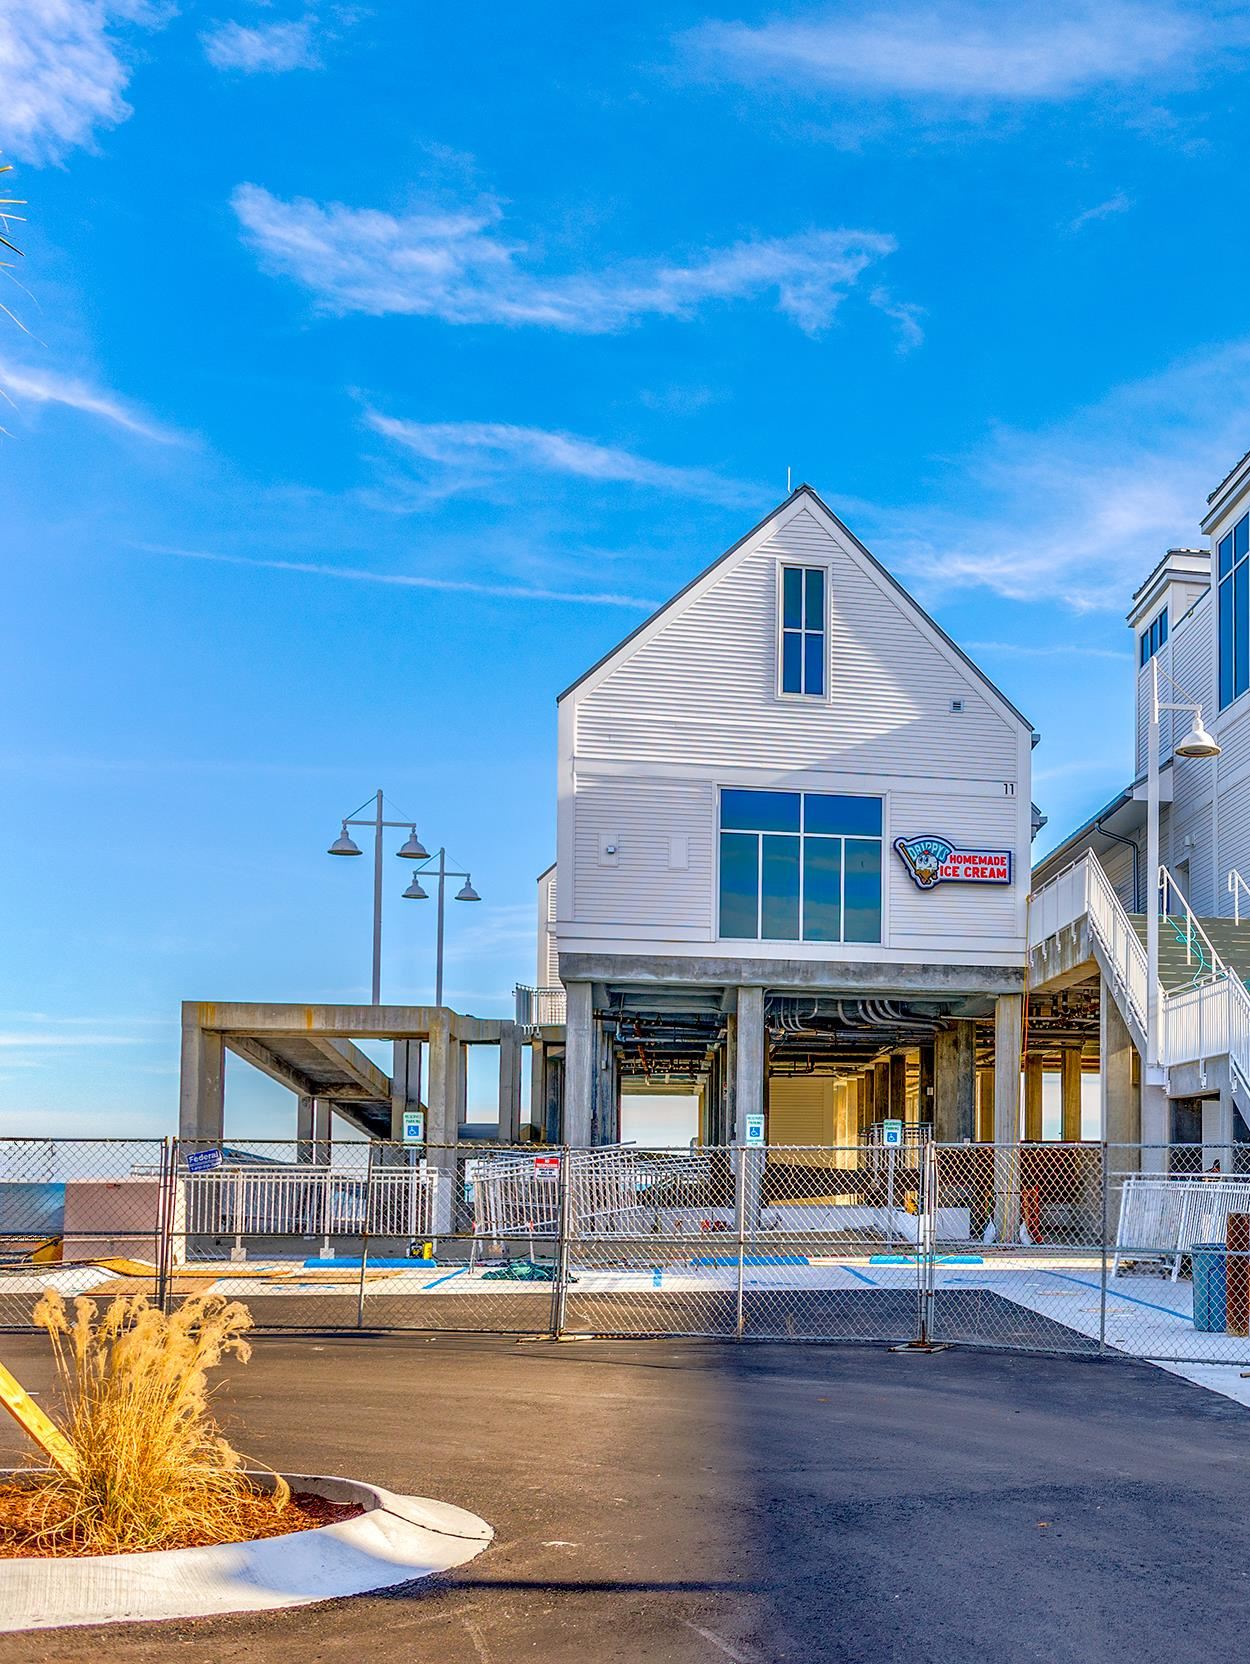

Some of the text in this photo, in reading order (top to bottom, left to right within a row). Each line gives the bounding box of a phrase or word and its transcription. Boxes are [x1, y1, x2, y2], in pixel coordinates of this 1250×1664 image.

[1003, 783, 1014, 795] 11
[949, 855, 1007, 866] HOMEMADE
[940, 866, 1007, 879] ICE CREAM
[188, 1151, 219, 1163] Federal
